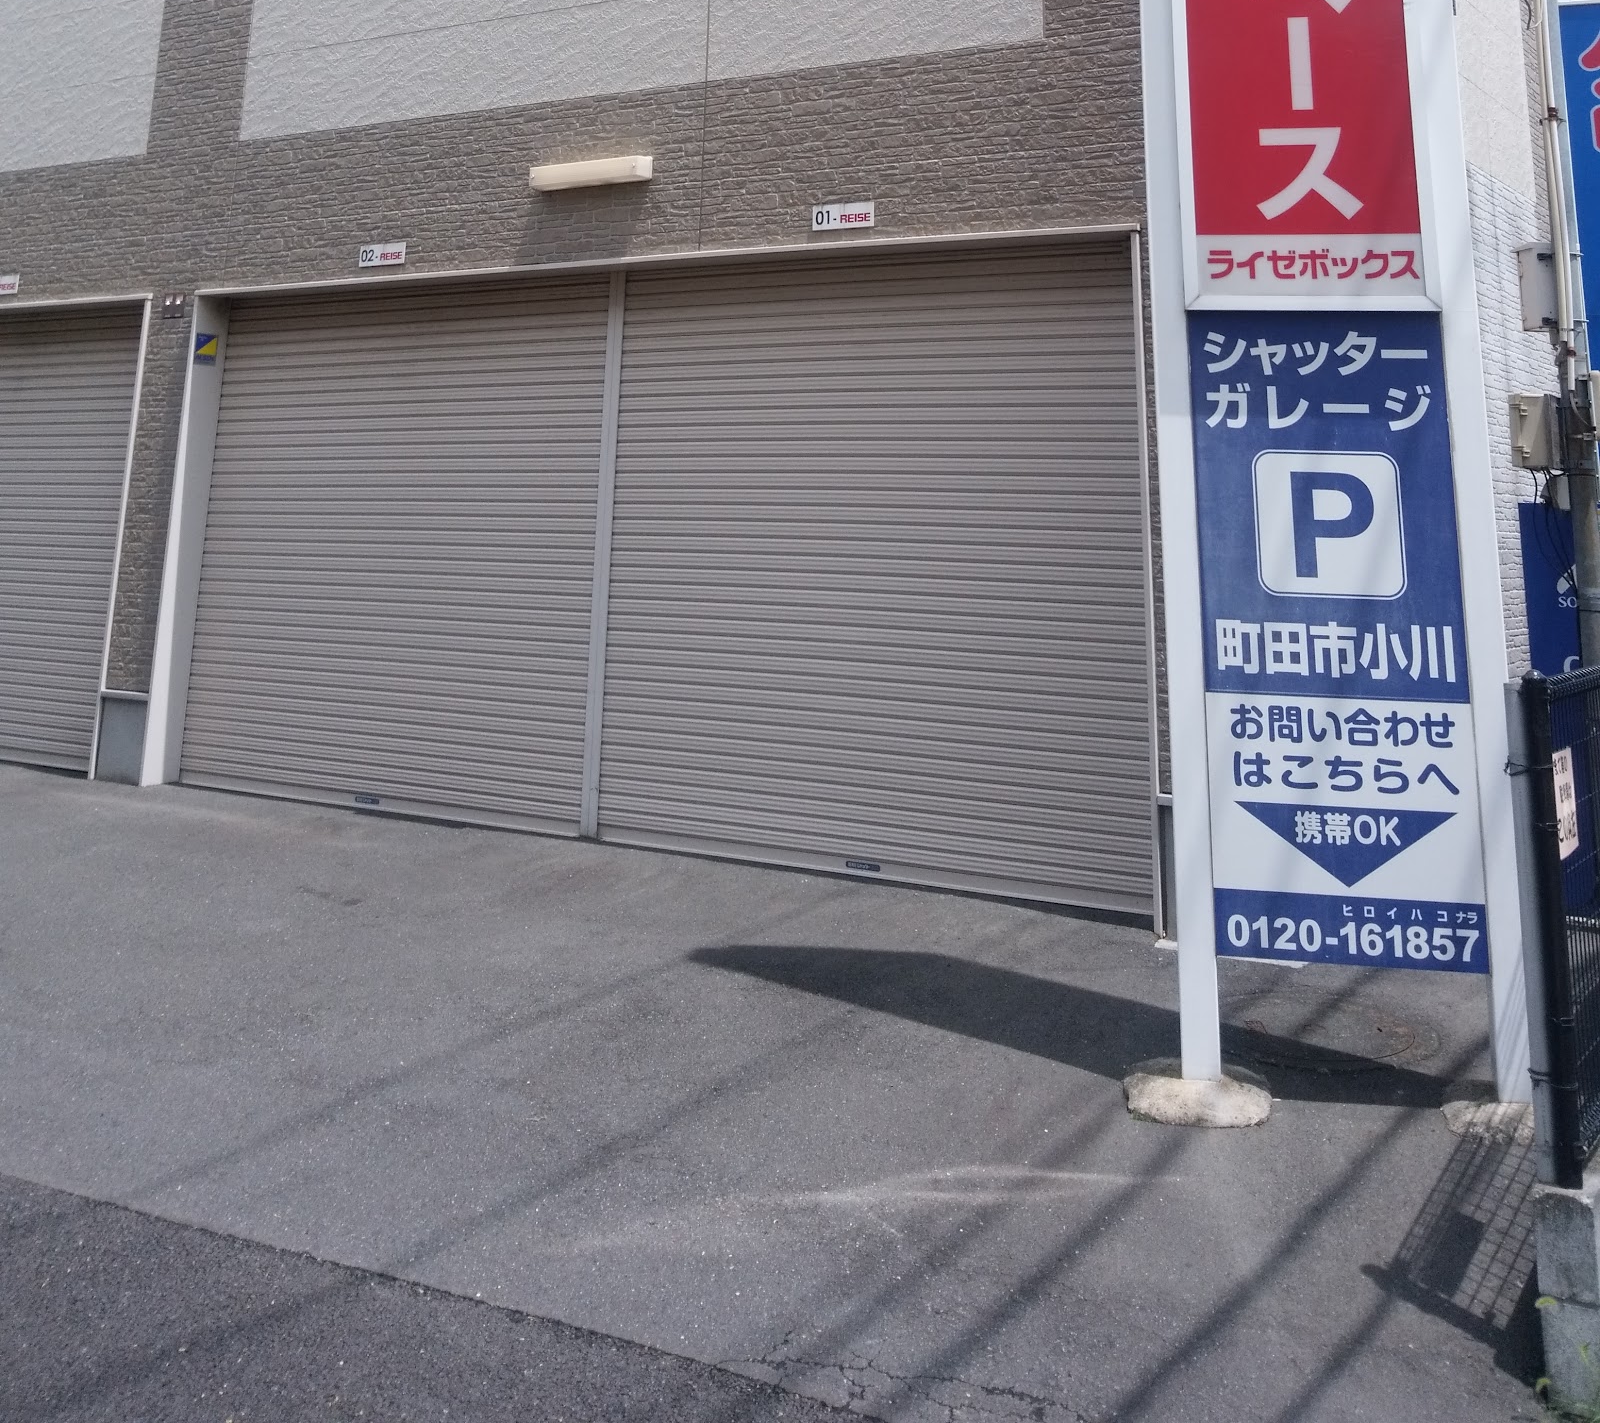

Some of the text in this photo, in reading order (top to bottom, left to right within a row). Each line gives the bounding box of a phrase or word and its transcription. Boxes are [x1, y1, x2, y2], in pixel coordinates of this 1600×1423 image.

[1207, 249, 1420, 281] ライゼボックス
[1203, 331, 1429, 377] シャッター
[1206, 384, 1431, 432] ガレージ
[1290, 471, 1375, 578] P
[1215, 619, 1456, 683] 町田市小川
[1230, 704, 1455, 749] お問い合わせ
[1233, 751, 1460, 796] はこちらへ
[1294, 812, 1401, 848] 携帯OK
[1227, 914, 1480, 963] 0120-161857
